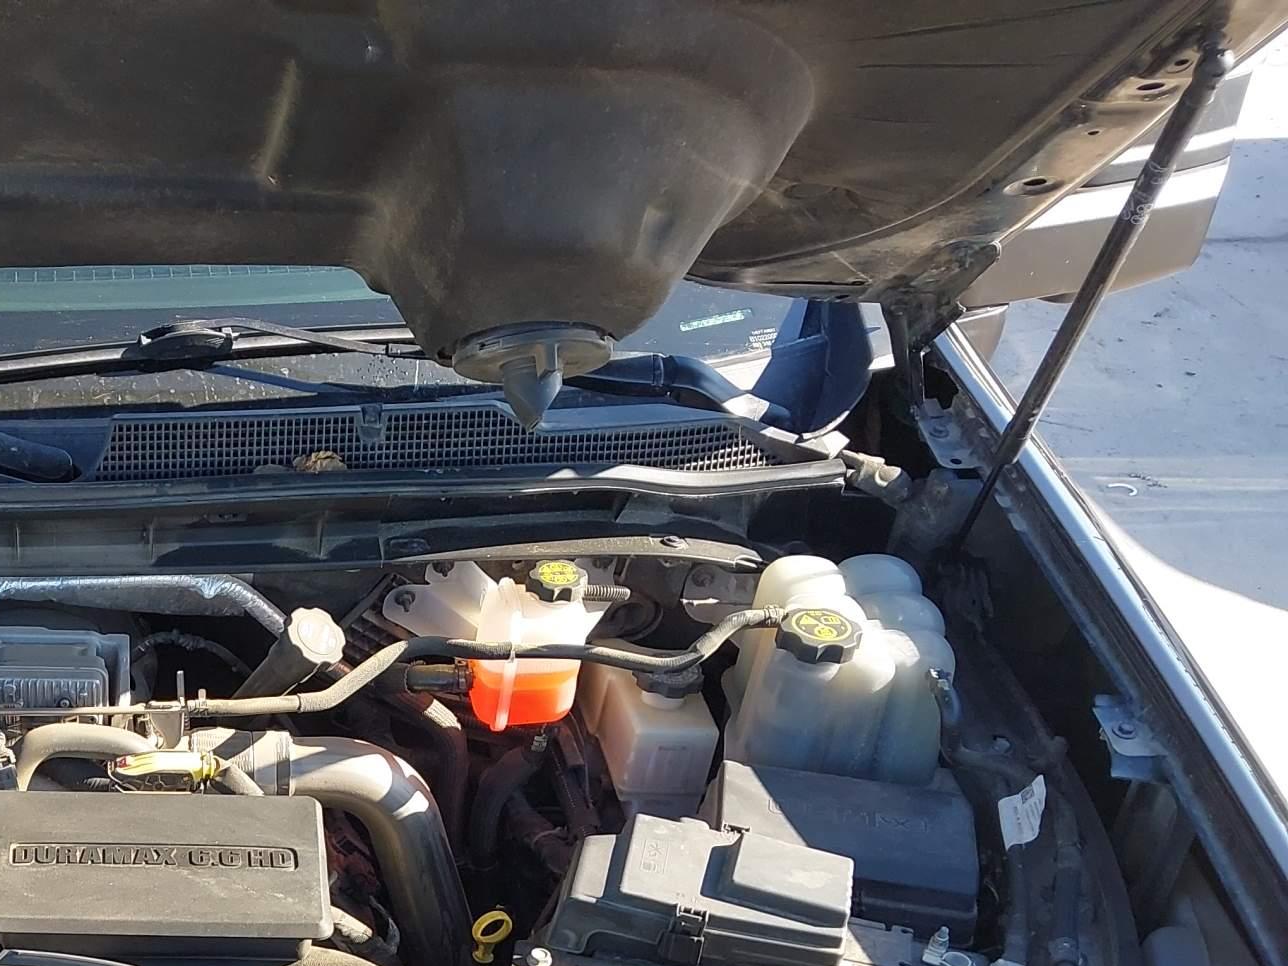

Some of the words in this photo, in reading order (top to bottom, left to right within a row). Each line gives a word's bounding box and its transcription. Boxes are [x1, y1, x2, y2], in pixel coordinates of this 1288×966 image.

[12, 845, 177, 867] DURAMAX
[188, 847, 242, 868] 6.6
[248, 848, 294, 869] HD
